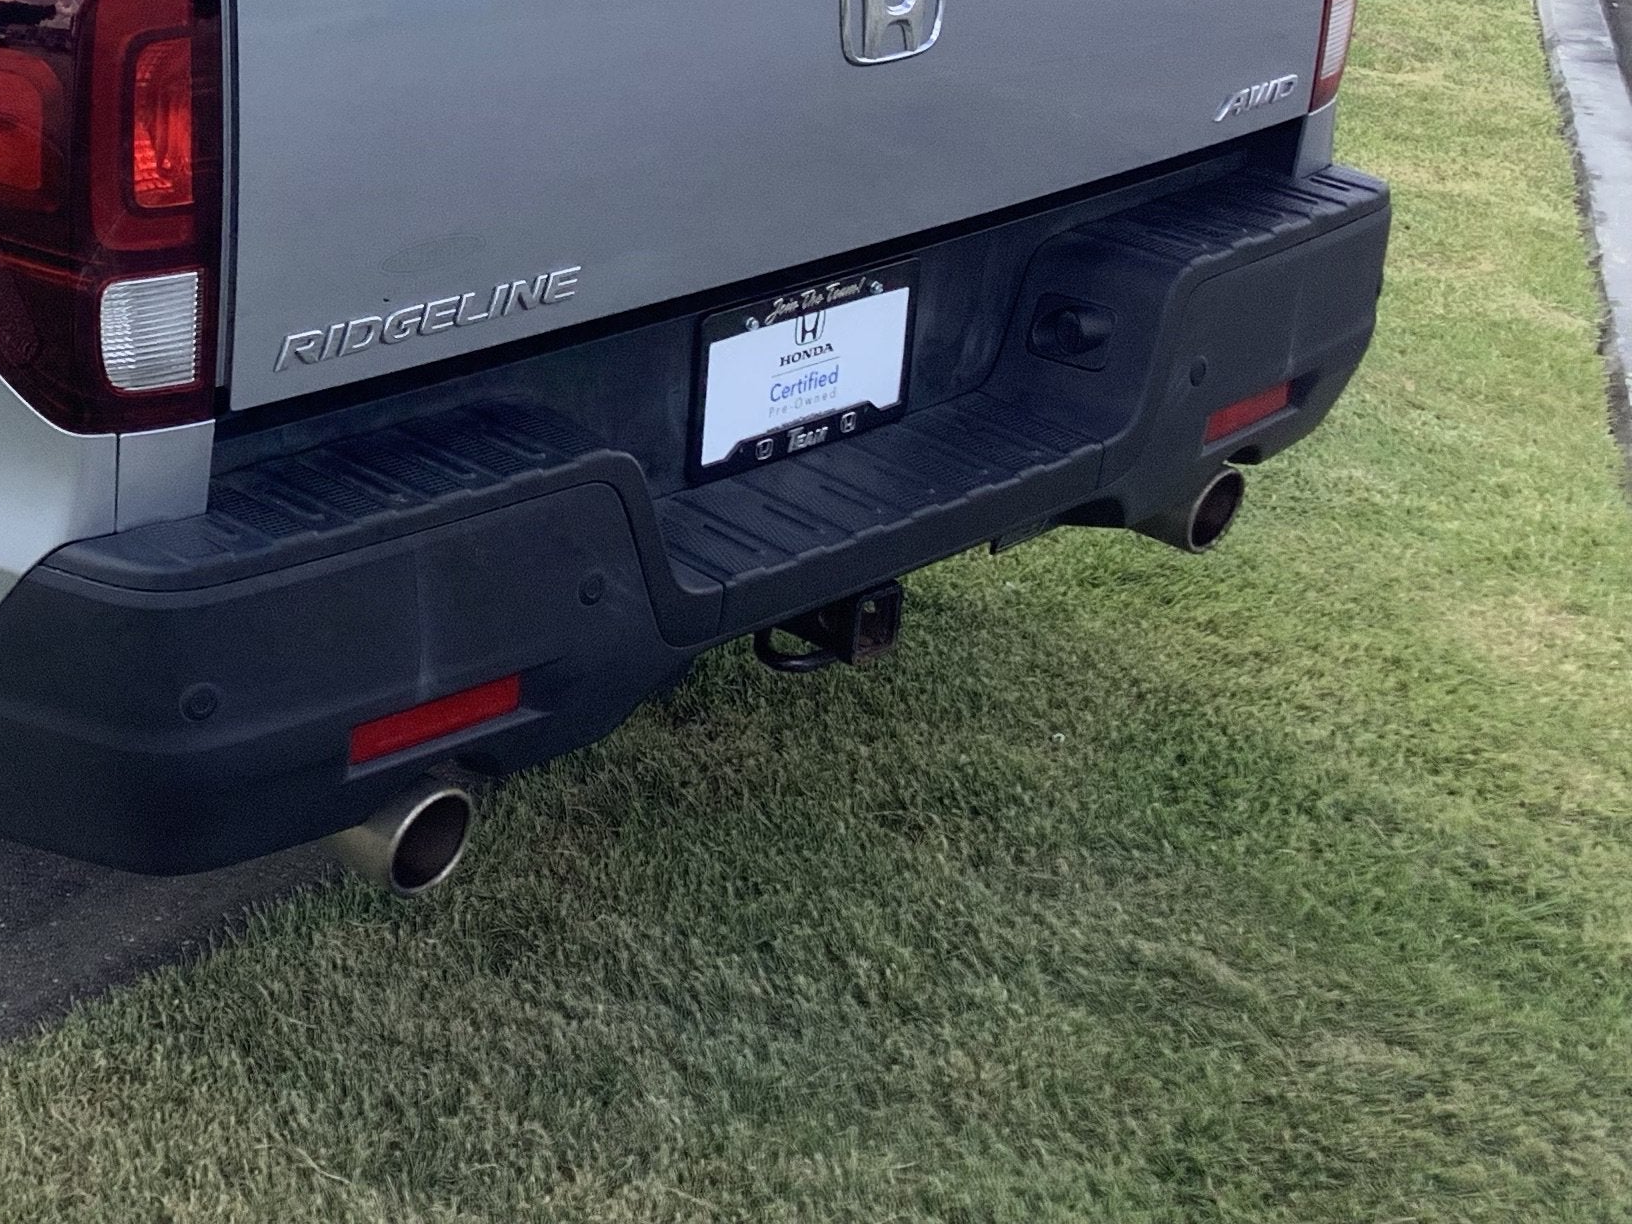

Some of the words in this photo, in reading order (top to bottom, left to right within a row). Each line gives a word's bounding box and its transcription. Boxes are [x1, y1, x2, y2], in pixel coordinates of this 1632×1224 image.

[1213, 74, 1298, 122] AWD
[273, 265, 582, 373] RIDGELINE
[764, 297, 799, 325] Join
[801, 288, 824, 310] The
[779, 343, 834, 367] HONDA
[770, 364, 839, 402] Certified
[768, 388, 837, 418] Pre-Owned
